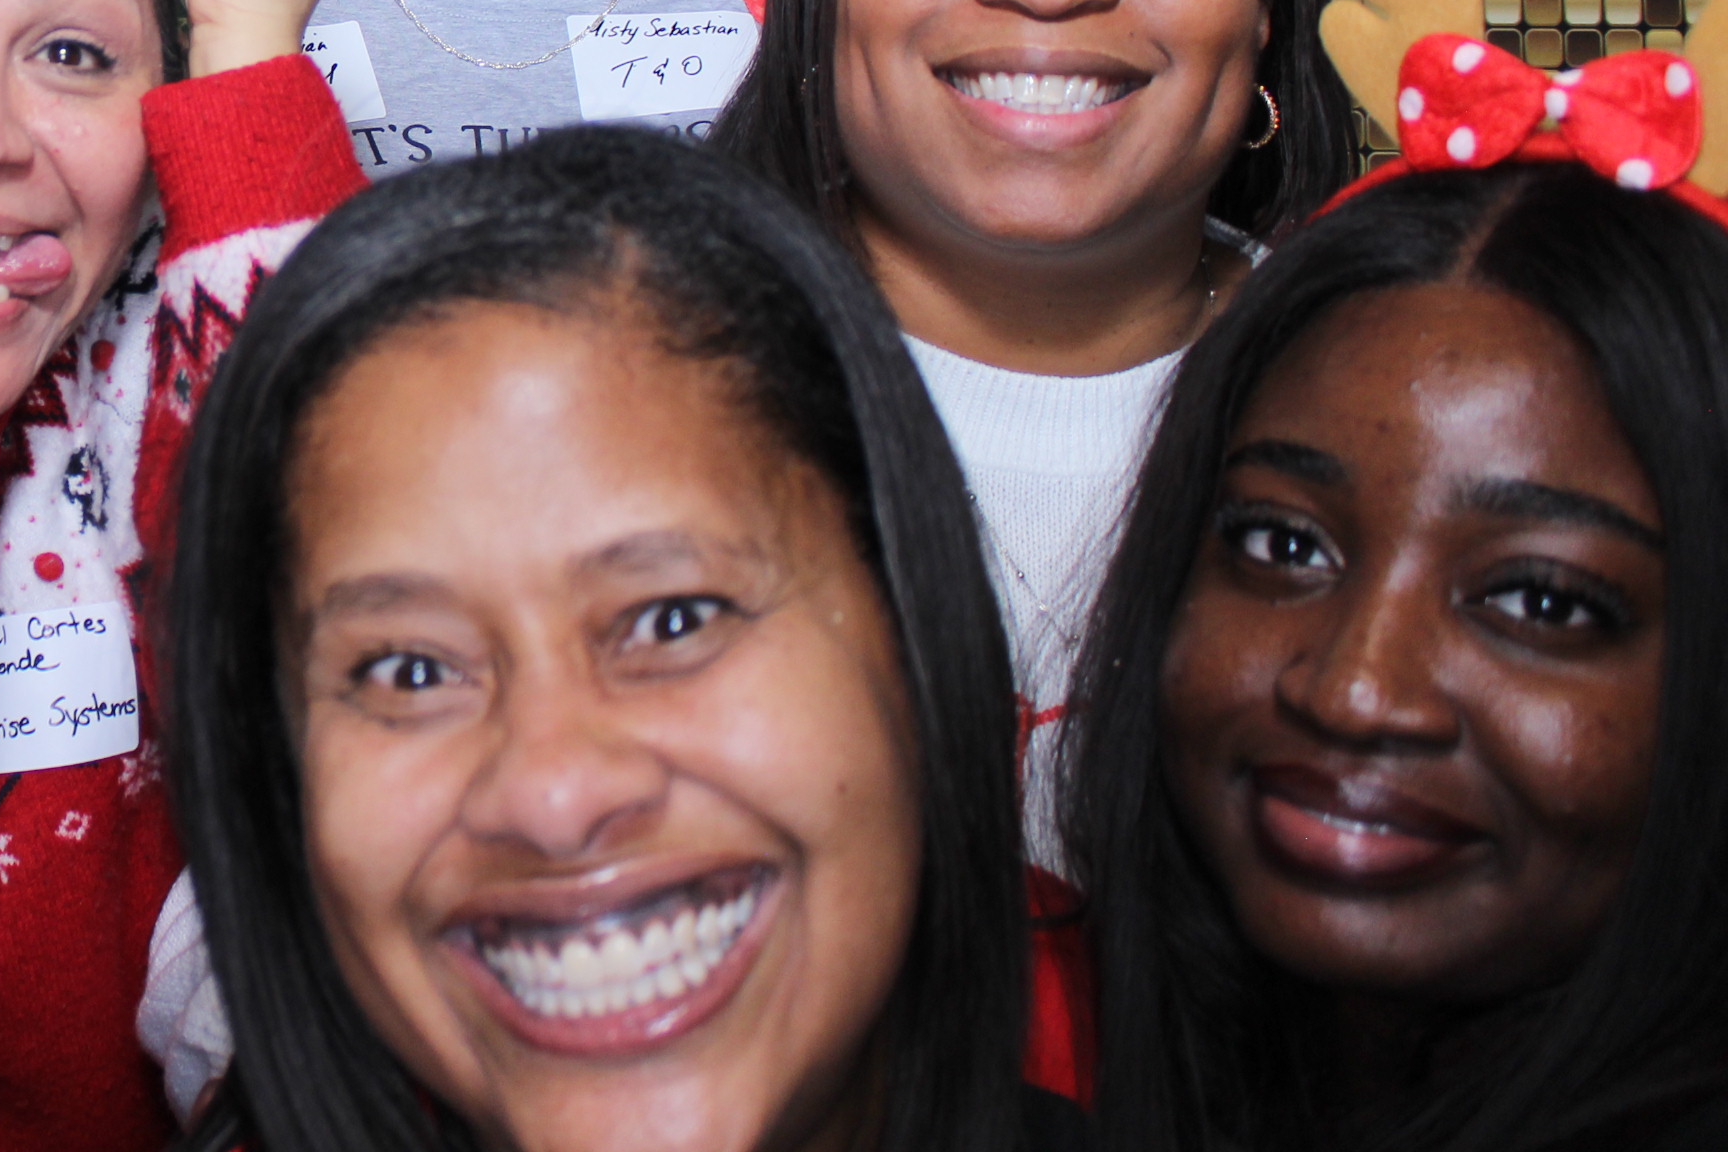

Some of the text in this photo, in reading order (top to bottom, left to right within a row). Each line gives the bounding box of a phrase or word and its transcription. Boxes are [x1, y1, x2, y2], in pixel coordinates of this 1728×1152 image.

[643, 16, 739, 38] Sebastian
[610, 55, 648, 88] T
[27, 611, 107, 641] Cortes
[48, 693, 137, 737] Systems
